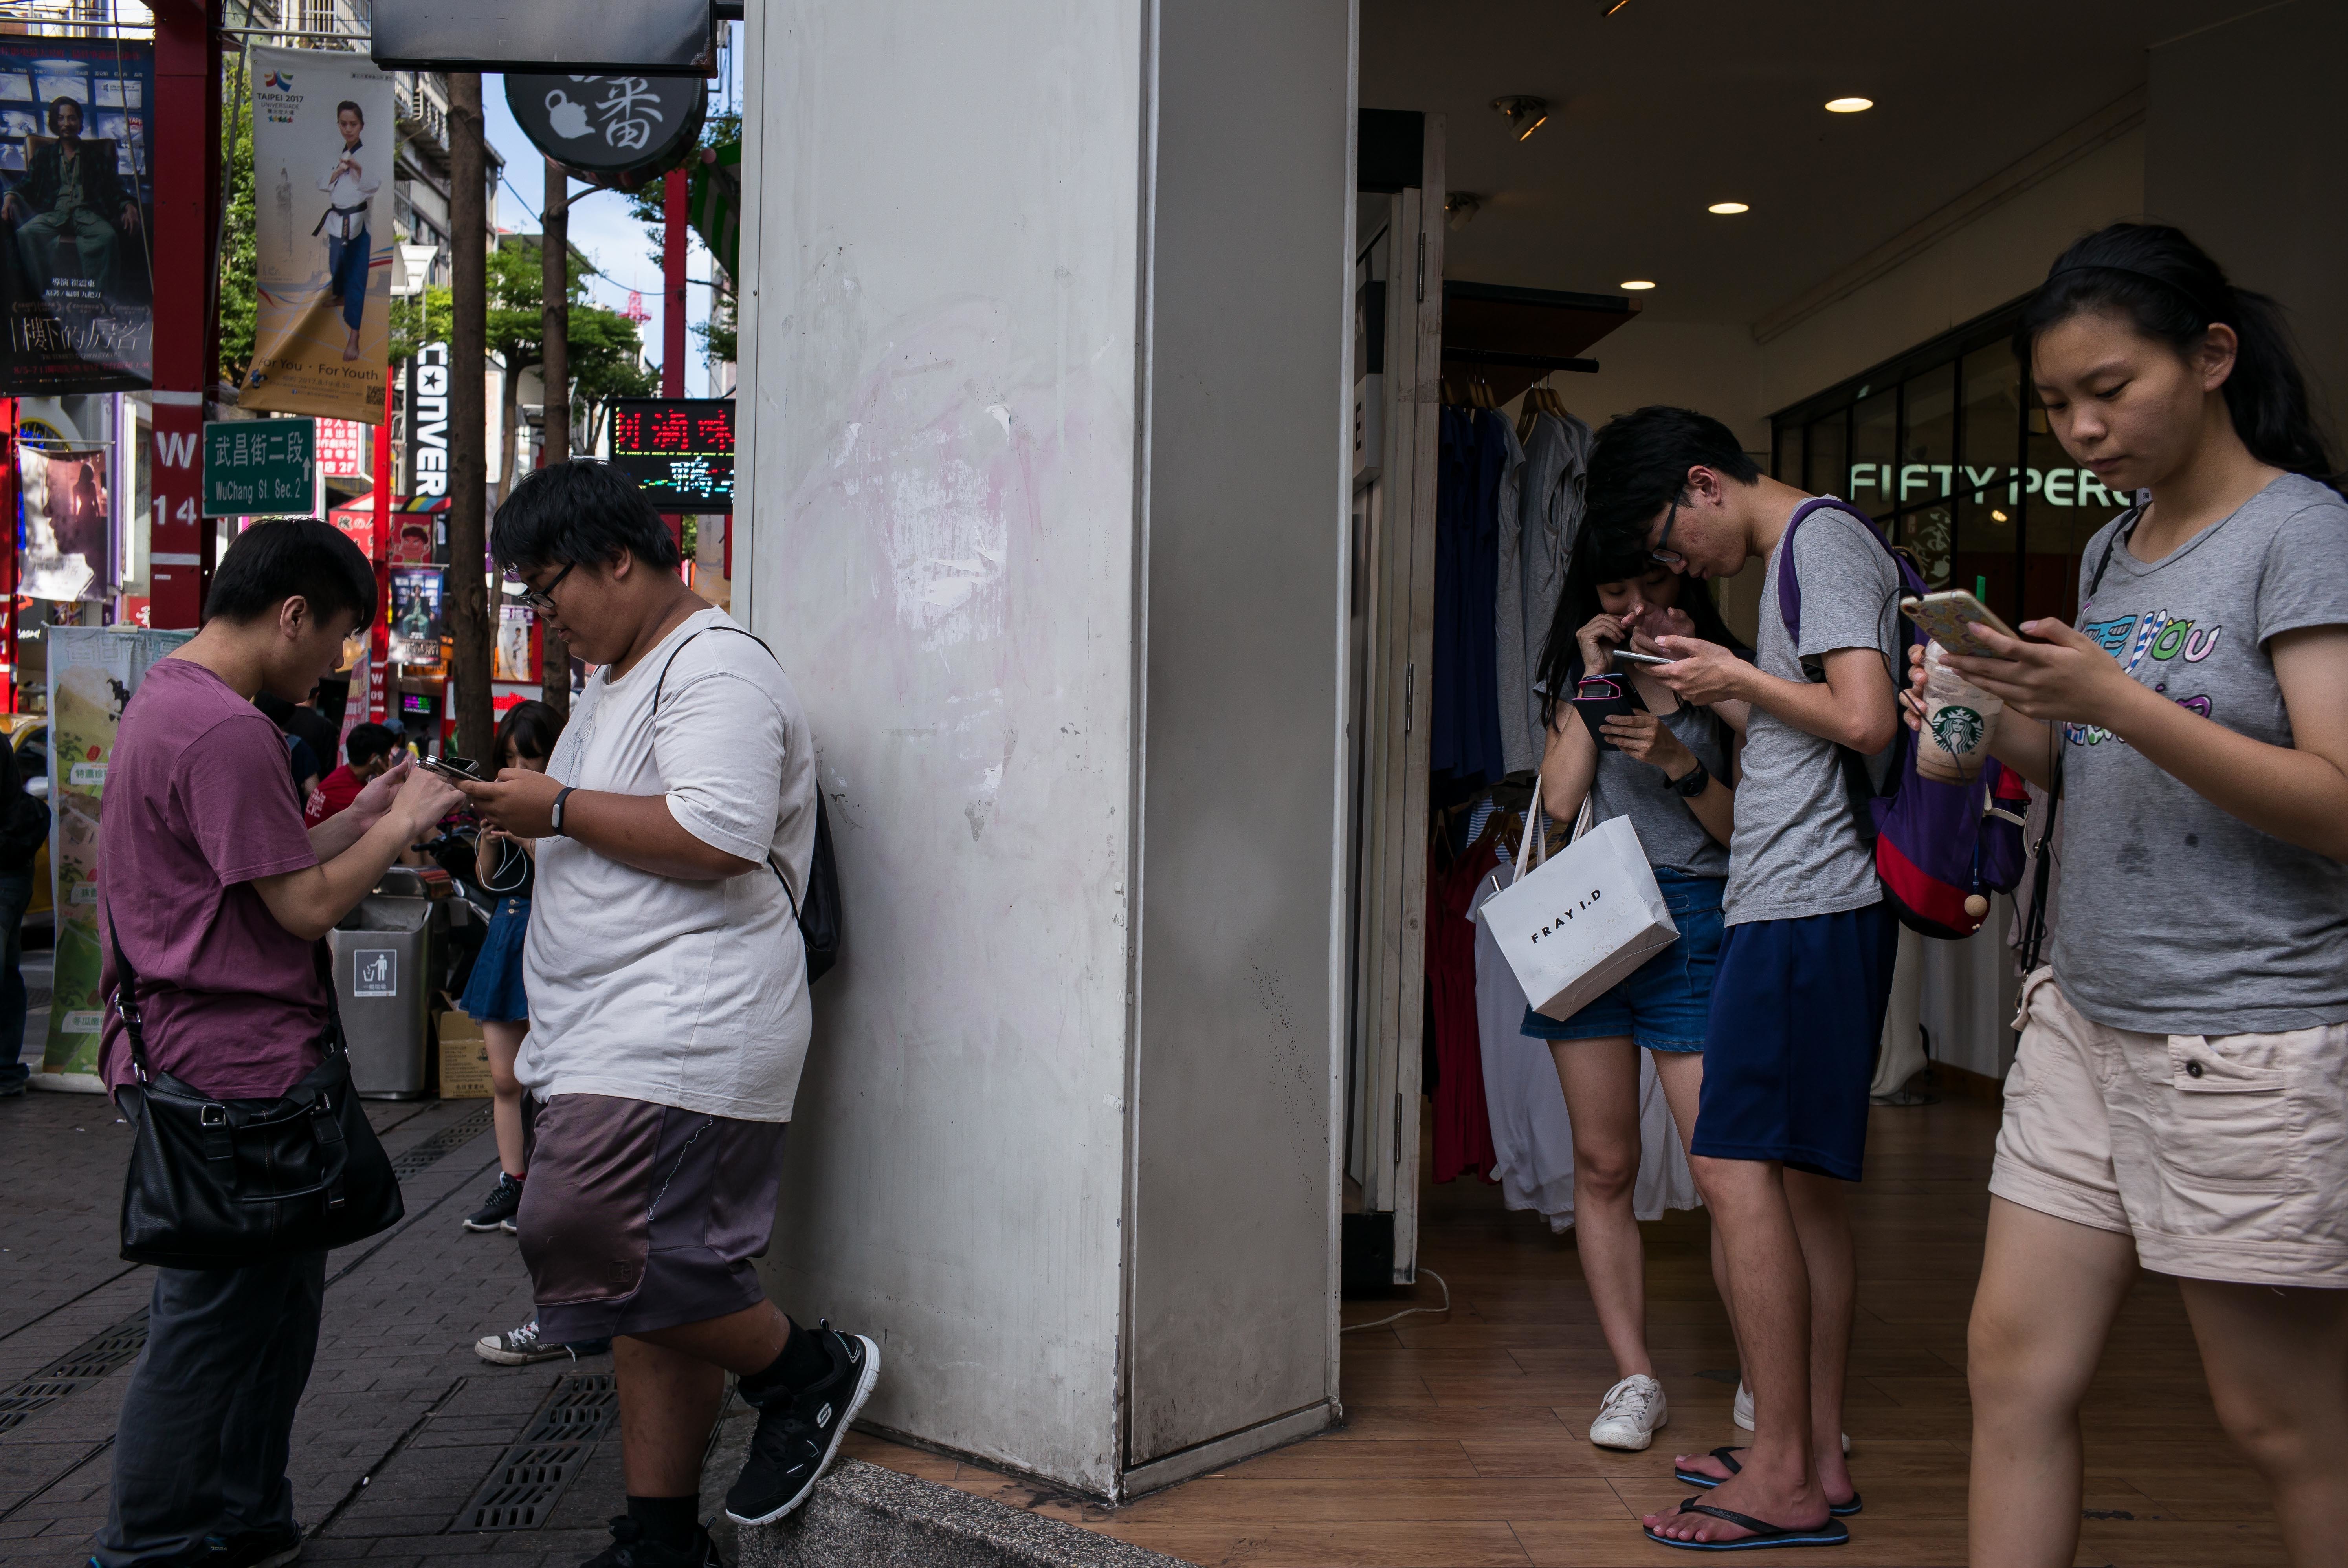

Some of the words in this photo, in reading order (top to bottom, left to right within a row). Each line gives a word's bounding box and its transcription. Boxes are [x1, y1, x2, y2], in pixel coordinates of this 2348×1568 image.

[257, 93, 282, 101] TAIPEI
[280, 359, 302, 371] You
[319, 364, 339, 376] For
[342, 366, 378, 380] Youth
[156, 432, 197, 468] W
[215, 432, 303, 467] 武昌街二段
[339, 462, 355, 473] 2F
[216, 481, 253, 504] WuChang
[259, 479, 269, 499] St.
[275, 478, 292, 499] Sec.
[295, 478, 300, 498] 2
[1851, 463, 1996, 504] FIFTY
[153, 495, 197, 525] 14
[371, 673, 383, 684] W
[371, 691, 384, 700] 09
[1531, 908, 1574, 944] FRAY
[1579, 889, 1601, 910] I.D
